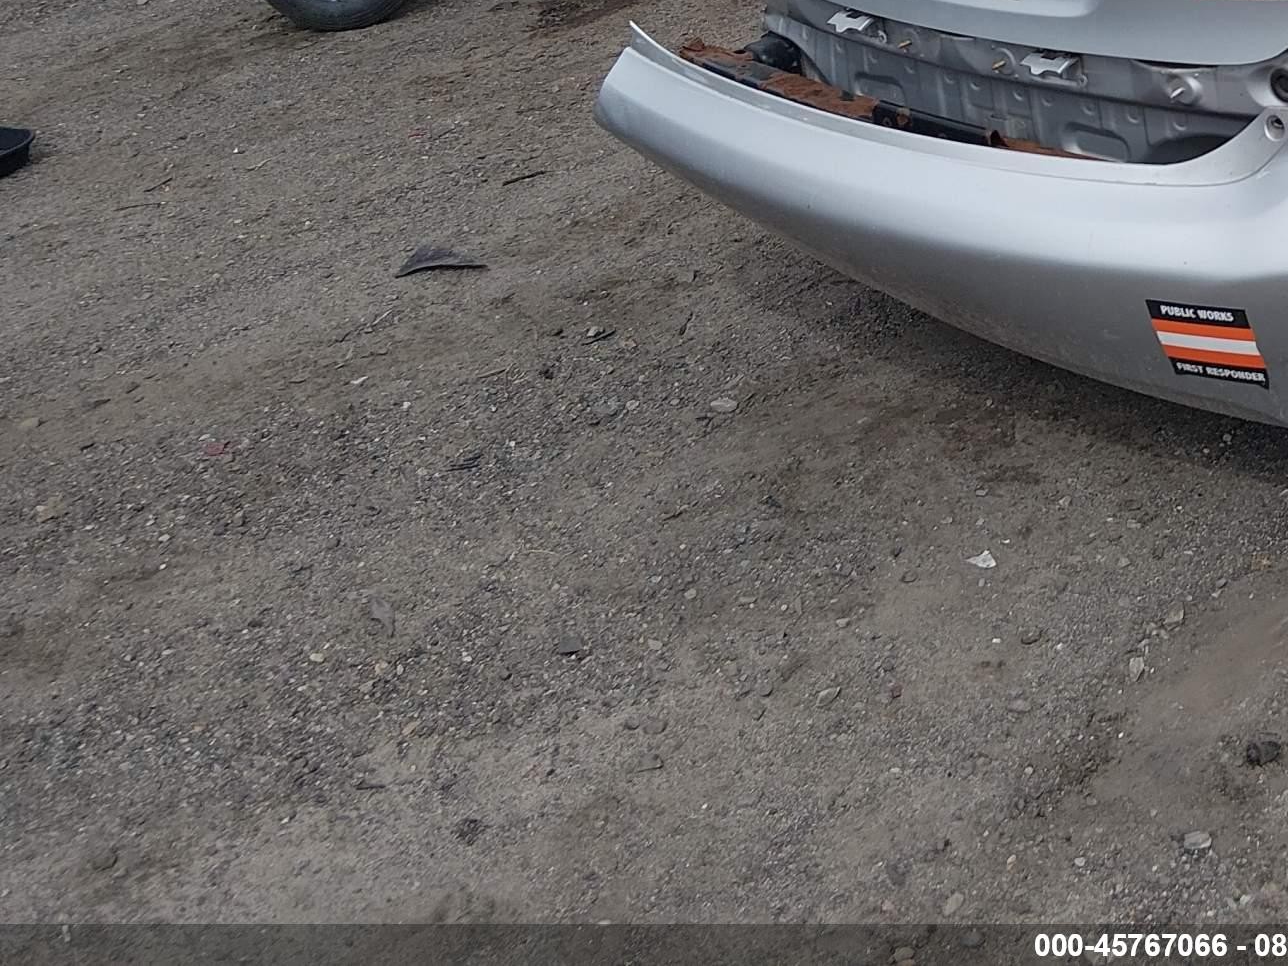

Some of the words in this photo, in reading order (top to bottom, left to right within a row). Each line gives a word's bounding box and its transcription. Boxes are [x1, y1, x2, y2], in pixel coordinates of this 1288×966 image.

[1160, 304, 1197, 319] PUBLIC
[1196, 309, 1235, 323] WORKS
[1176, 362, 1204, 375] FIRST
[1206, 367, 1266, 383] RESPONDER
